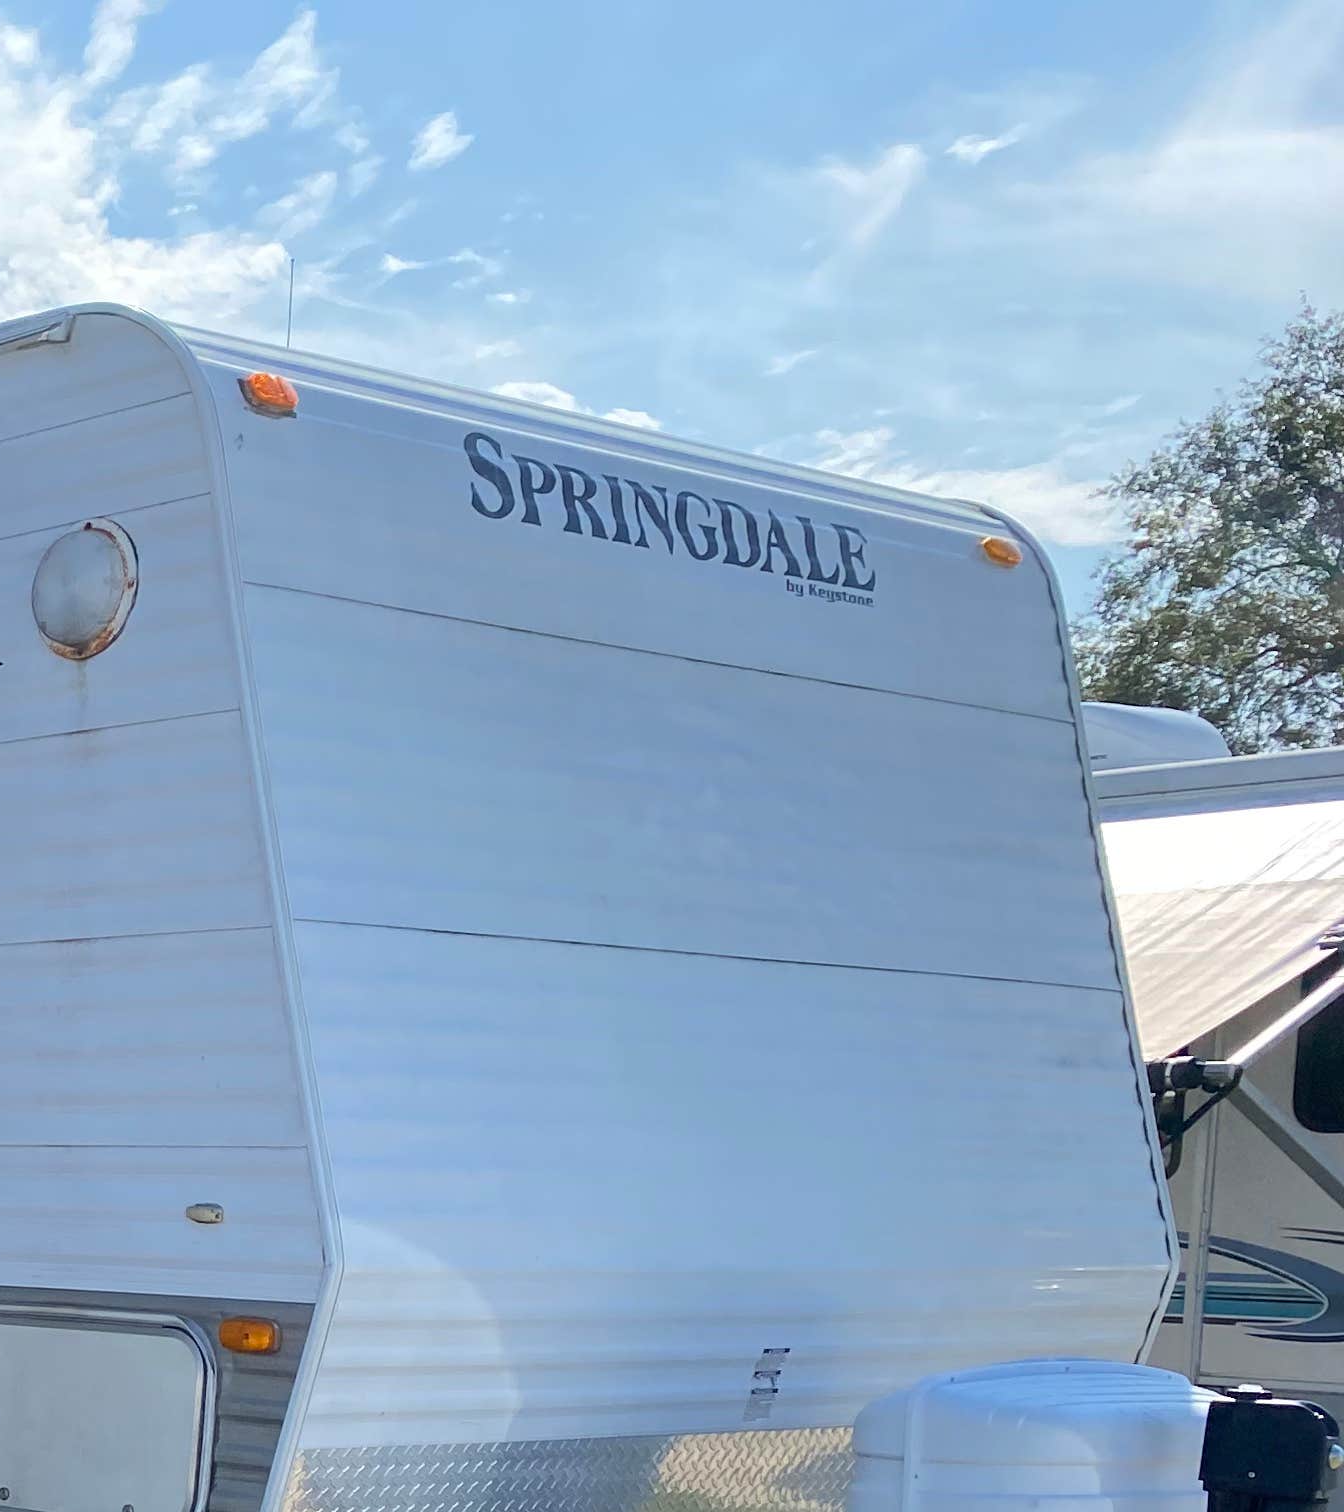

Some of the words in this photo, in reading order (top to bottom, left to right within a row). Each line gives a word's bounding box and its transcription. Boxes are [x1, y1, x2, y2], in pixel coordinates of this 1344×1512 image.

[464, 432, 877, 592] SPRINGDALE
[786, 579, 804, 597] by
[808, 583, 875, 608] Keystone
